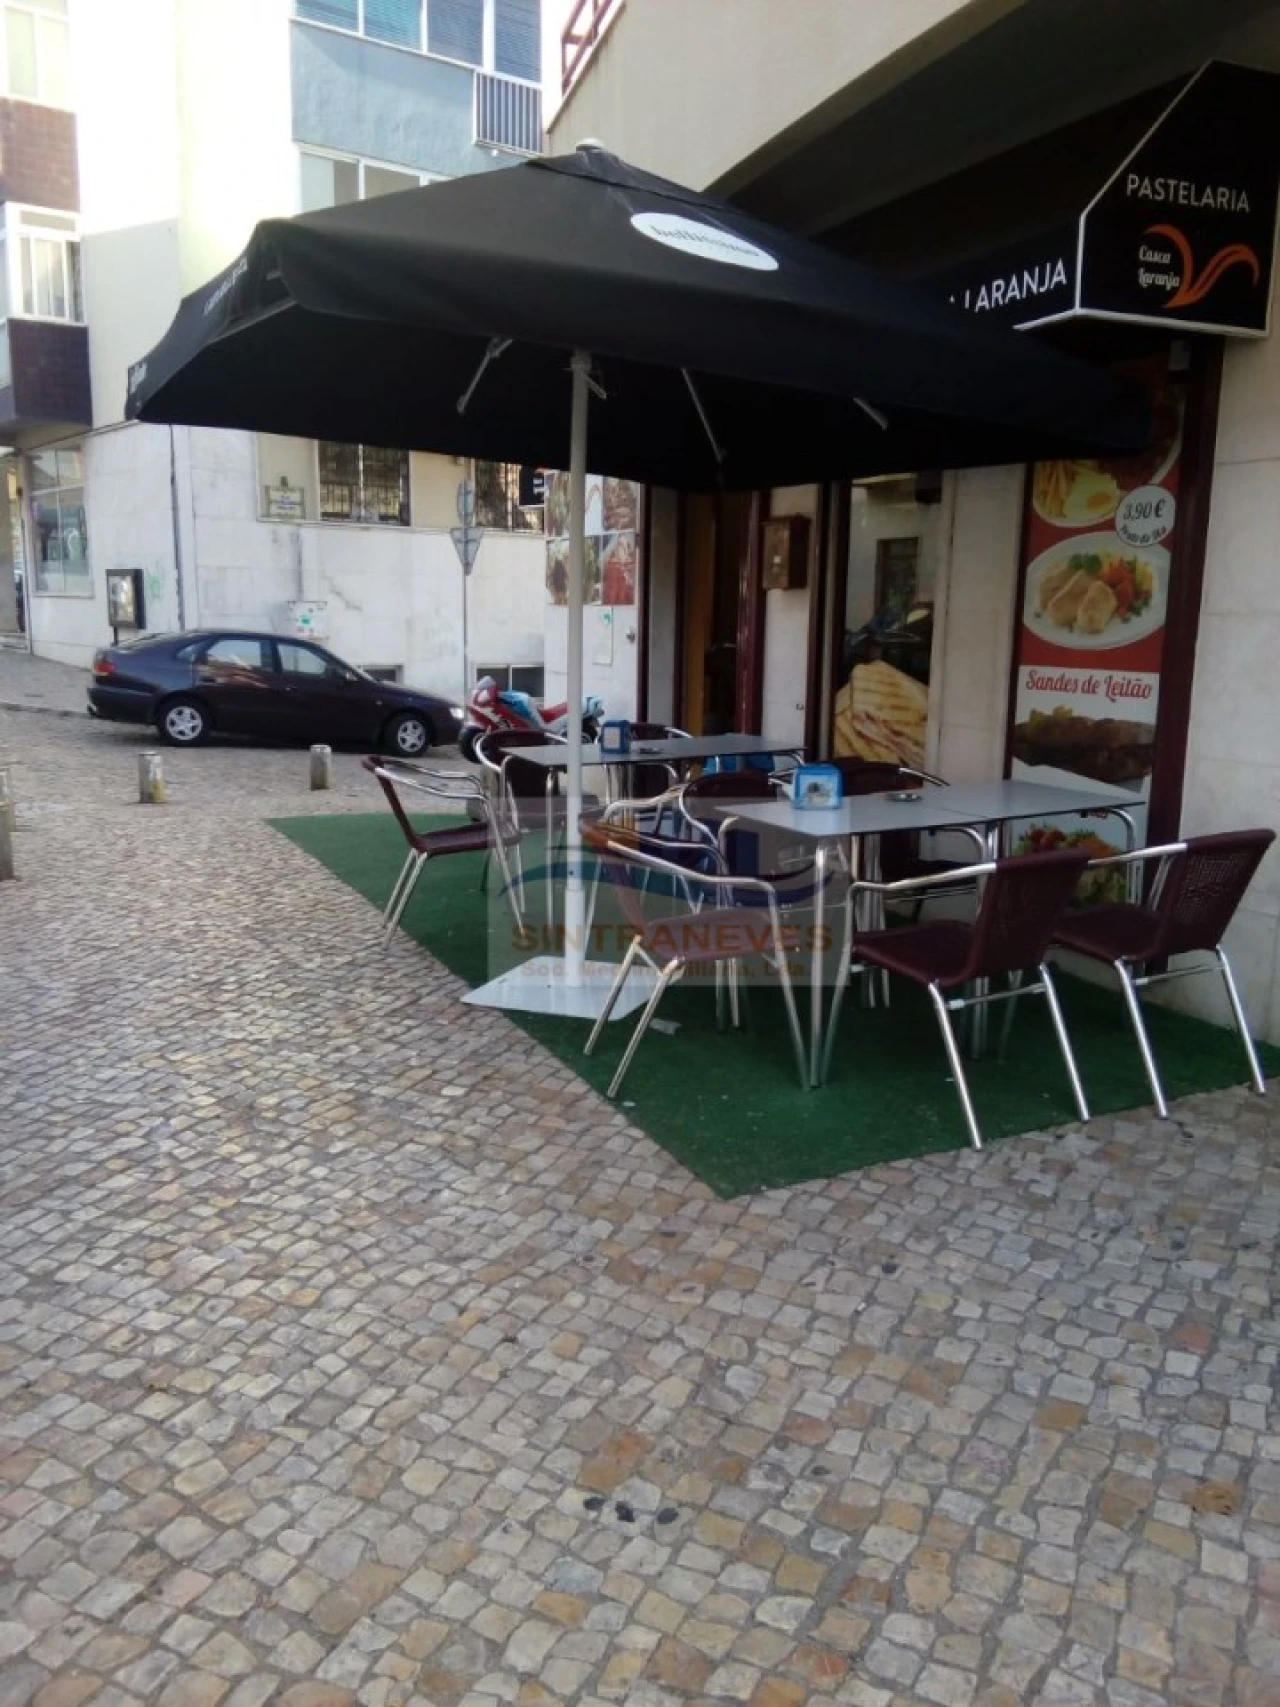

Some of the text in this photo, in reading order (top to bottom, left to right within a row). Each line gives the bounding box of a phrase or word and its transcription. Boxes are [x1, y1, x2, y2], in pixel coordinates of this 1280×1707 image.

[1126, 173, 1250, 213] PASTELARIA
[1154, 497, 1166, 519] €
[1026, 670, 1153, 703] Sandes de Leitão
